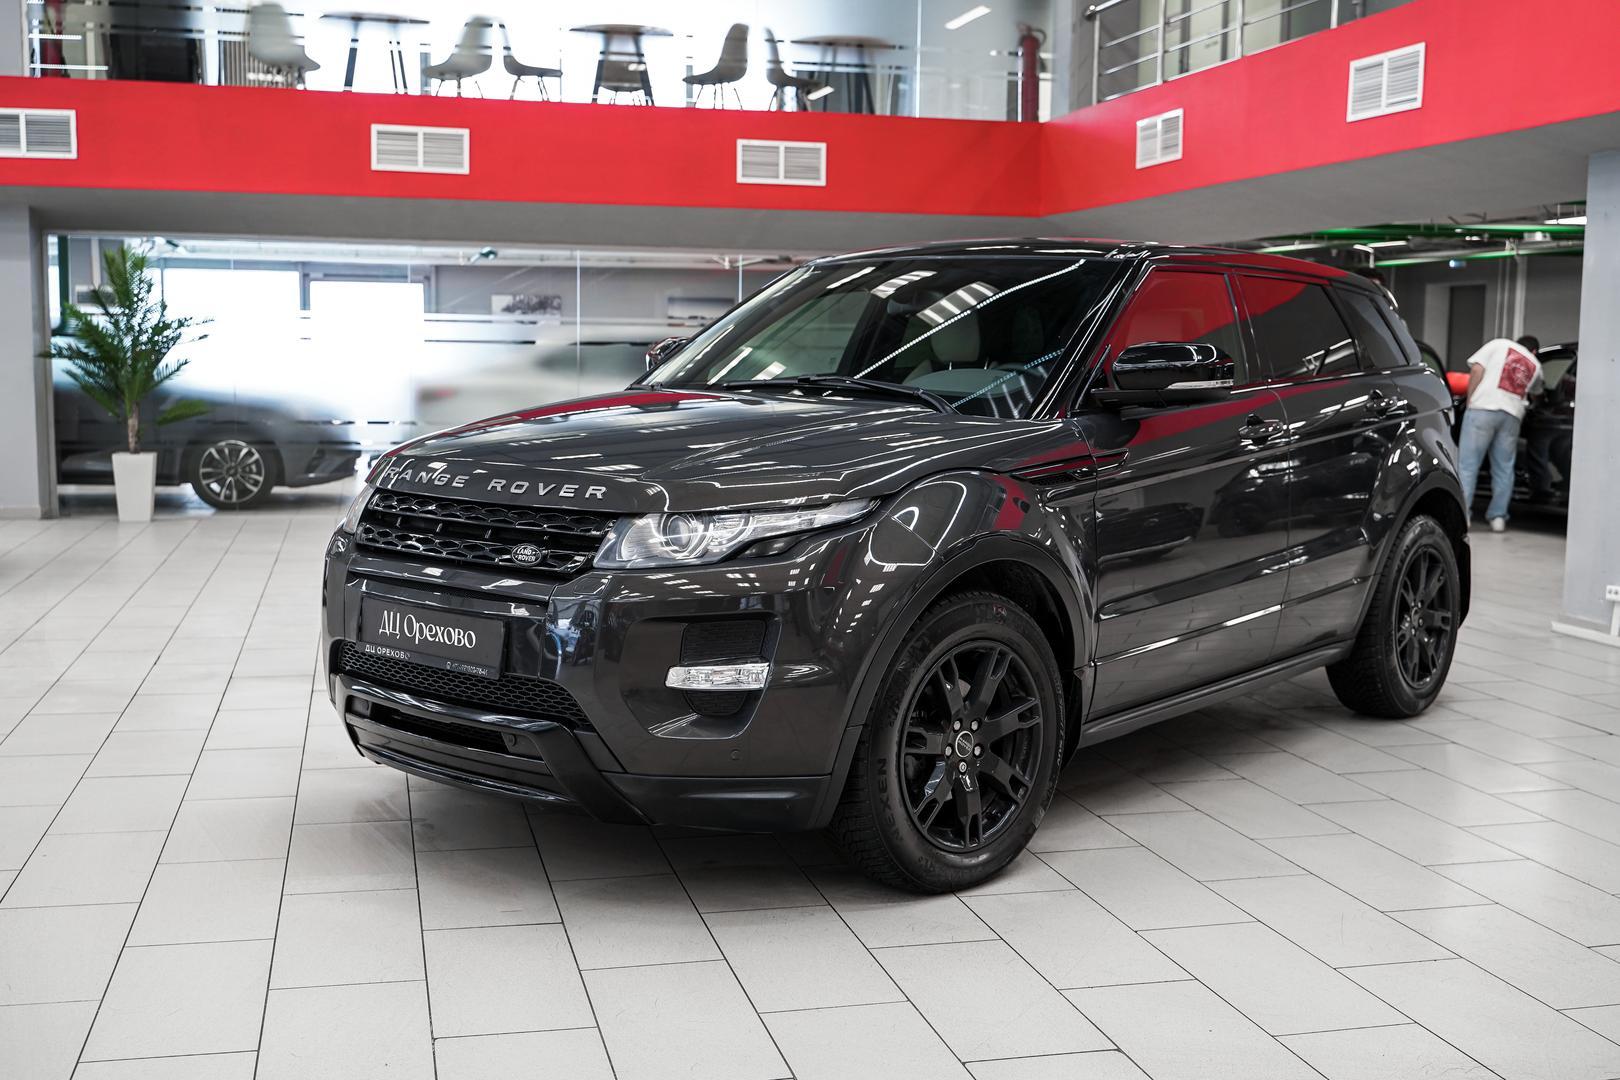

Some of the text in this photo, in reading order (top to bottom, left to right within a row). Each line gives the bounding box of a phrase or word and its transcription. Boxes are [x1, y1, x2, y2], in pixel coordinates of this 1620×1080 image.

[384, 466, 607, 499] RANGE ROVER
[516, 548, 532, 556] LAND
[517, 554, 536, 562] ROVER
[378, 610, 476, 648] ДЦ Орехово
